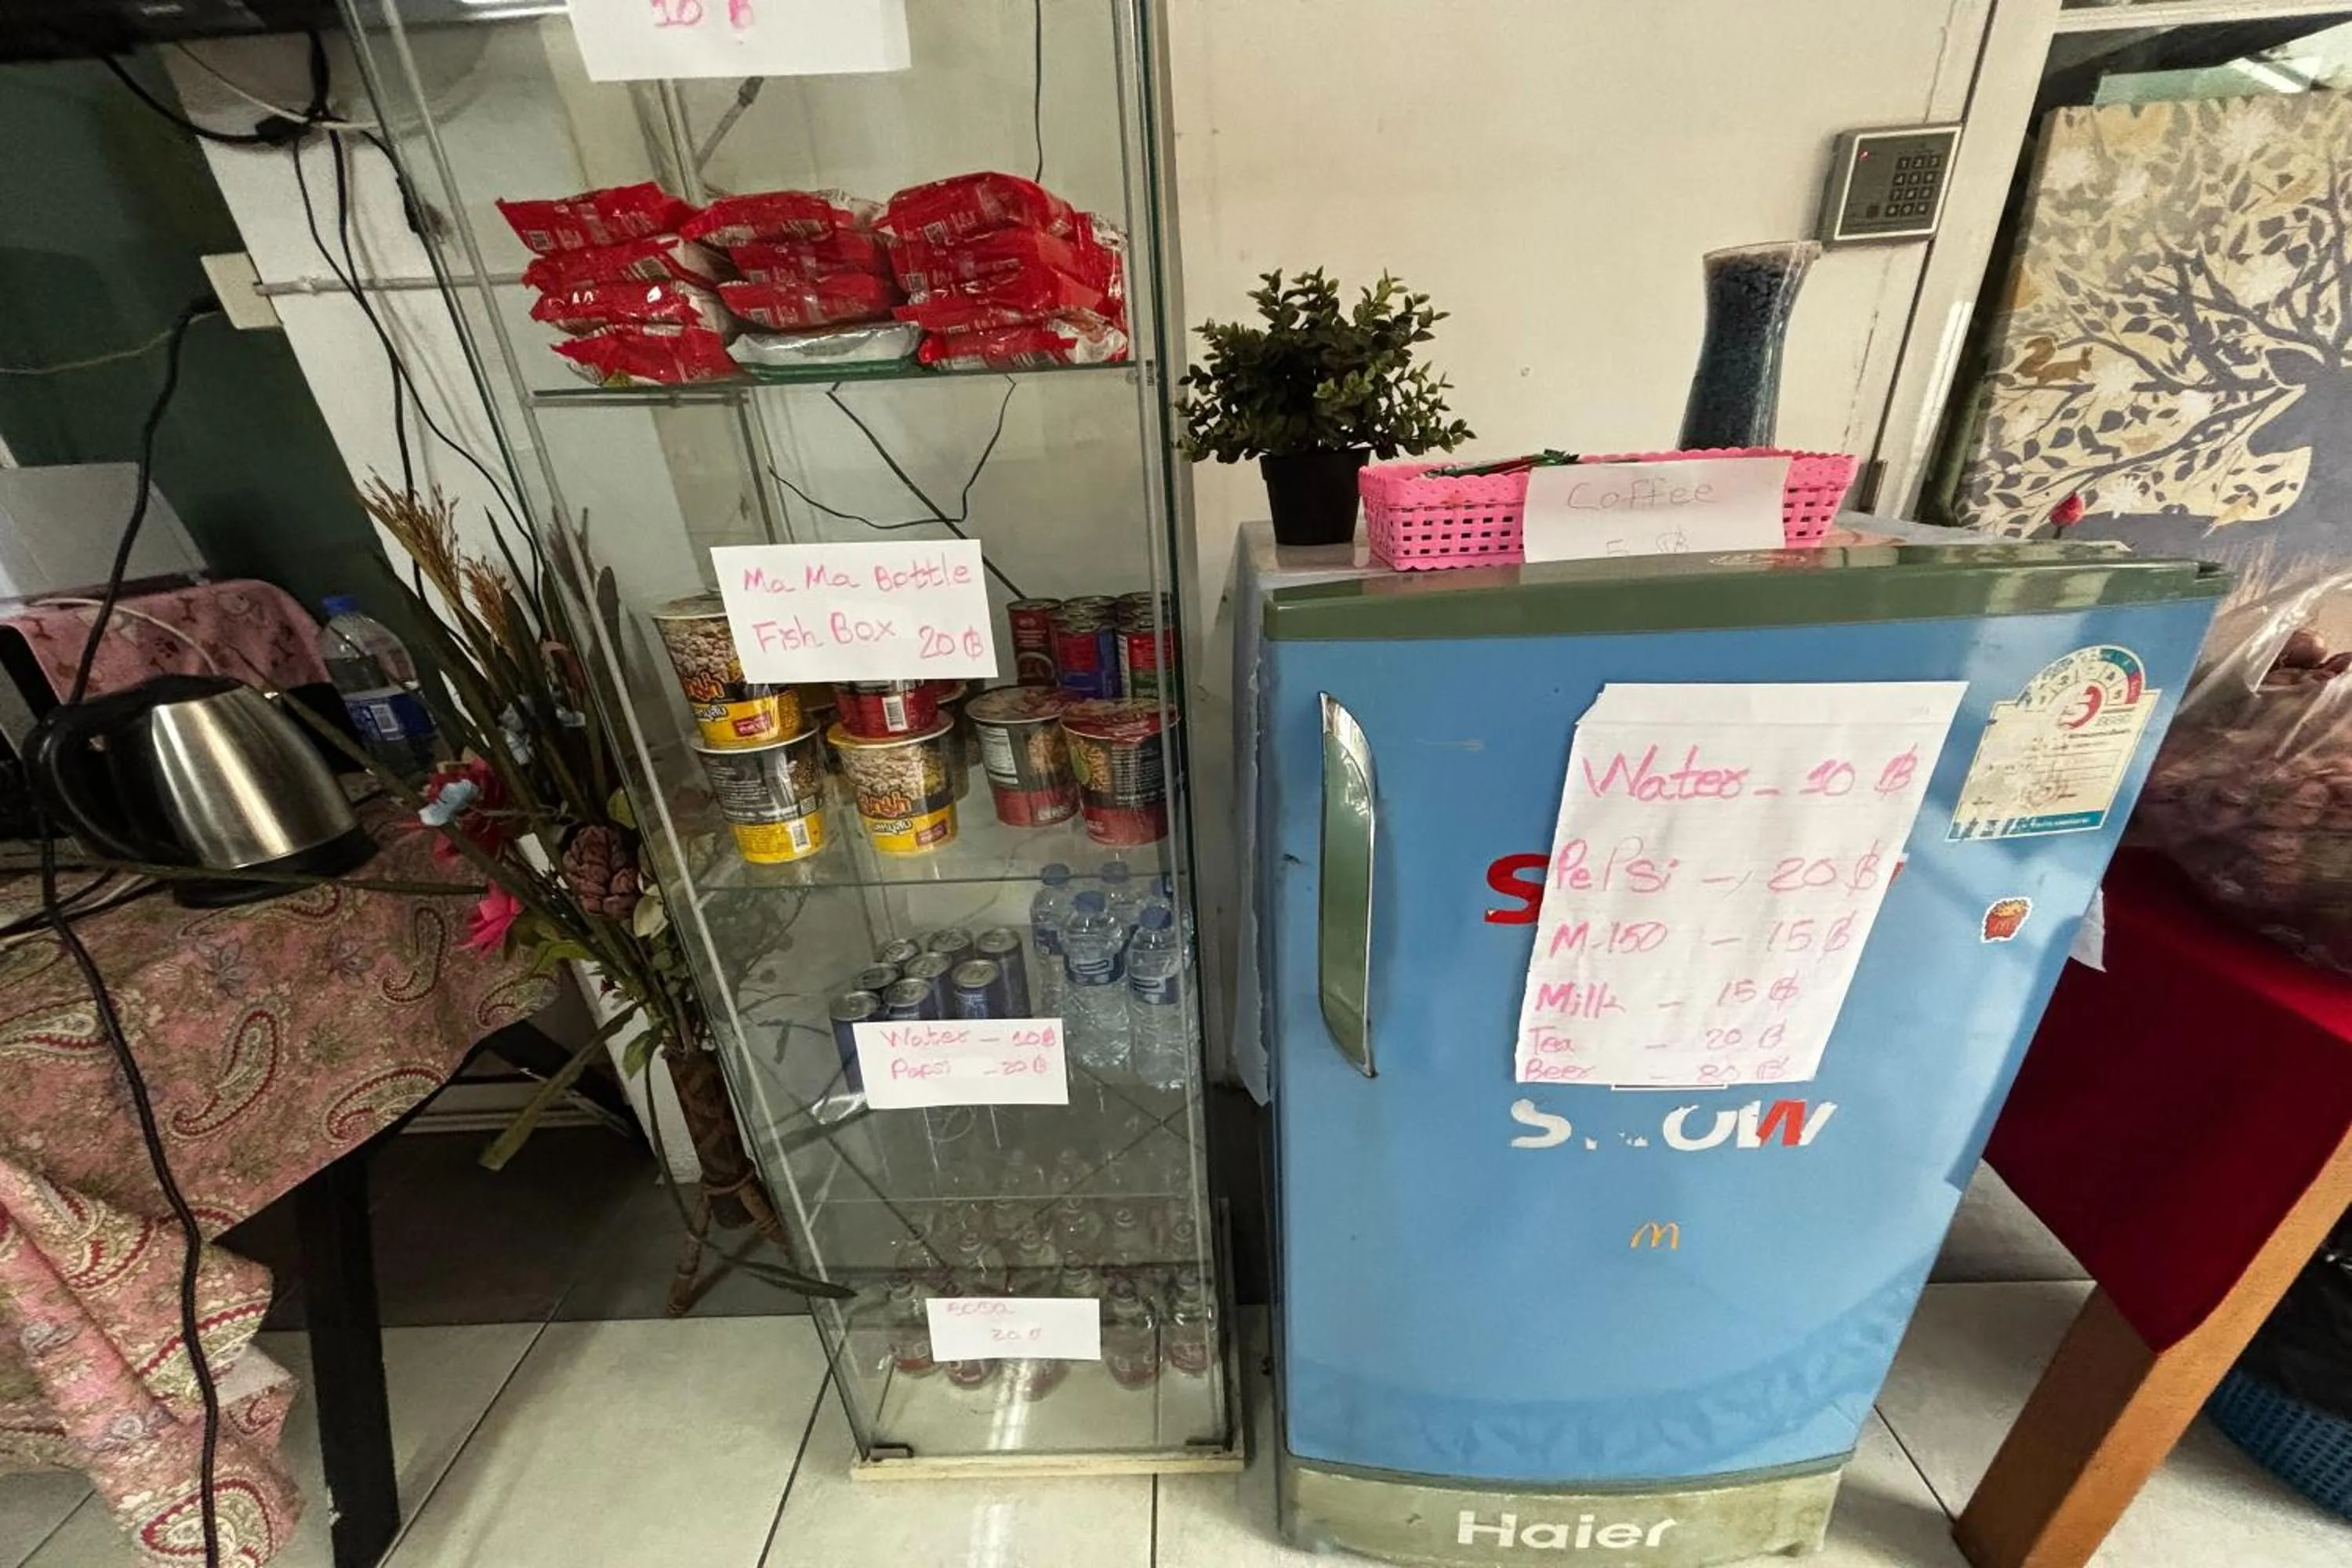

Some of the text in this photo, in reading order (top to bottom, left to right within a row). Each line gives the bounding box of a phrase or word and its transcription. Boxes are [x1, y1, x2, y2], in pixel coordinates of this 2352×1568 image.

[1567, 477, 1719, 510] Coffee
[742, 552, 971, 593] Ma Ma Bottle
[752, 615, 826, 653] Fish
[829, 611, 898, 644] Box
[1582, 744, 1749, 802] Water
[1534, 981, 1625, 1019] Milk
[880, 1025, 972, 1047] Water
[1527, 1025, 1576, 1054] Tea
[1524, 1058, 1596, 1081] Beer
[1457, 1510, 1678, 1550] Haier
